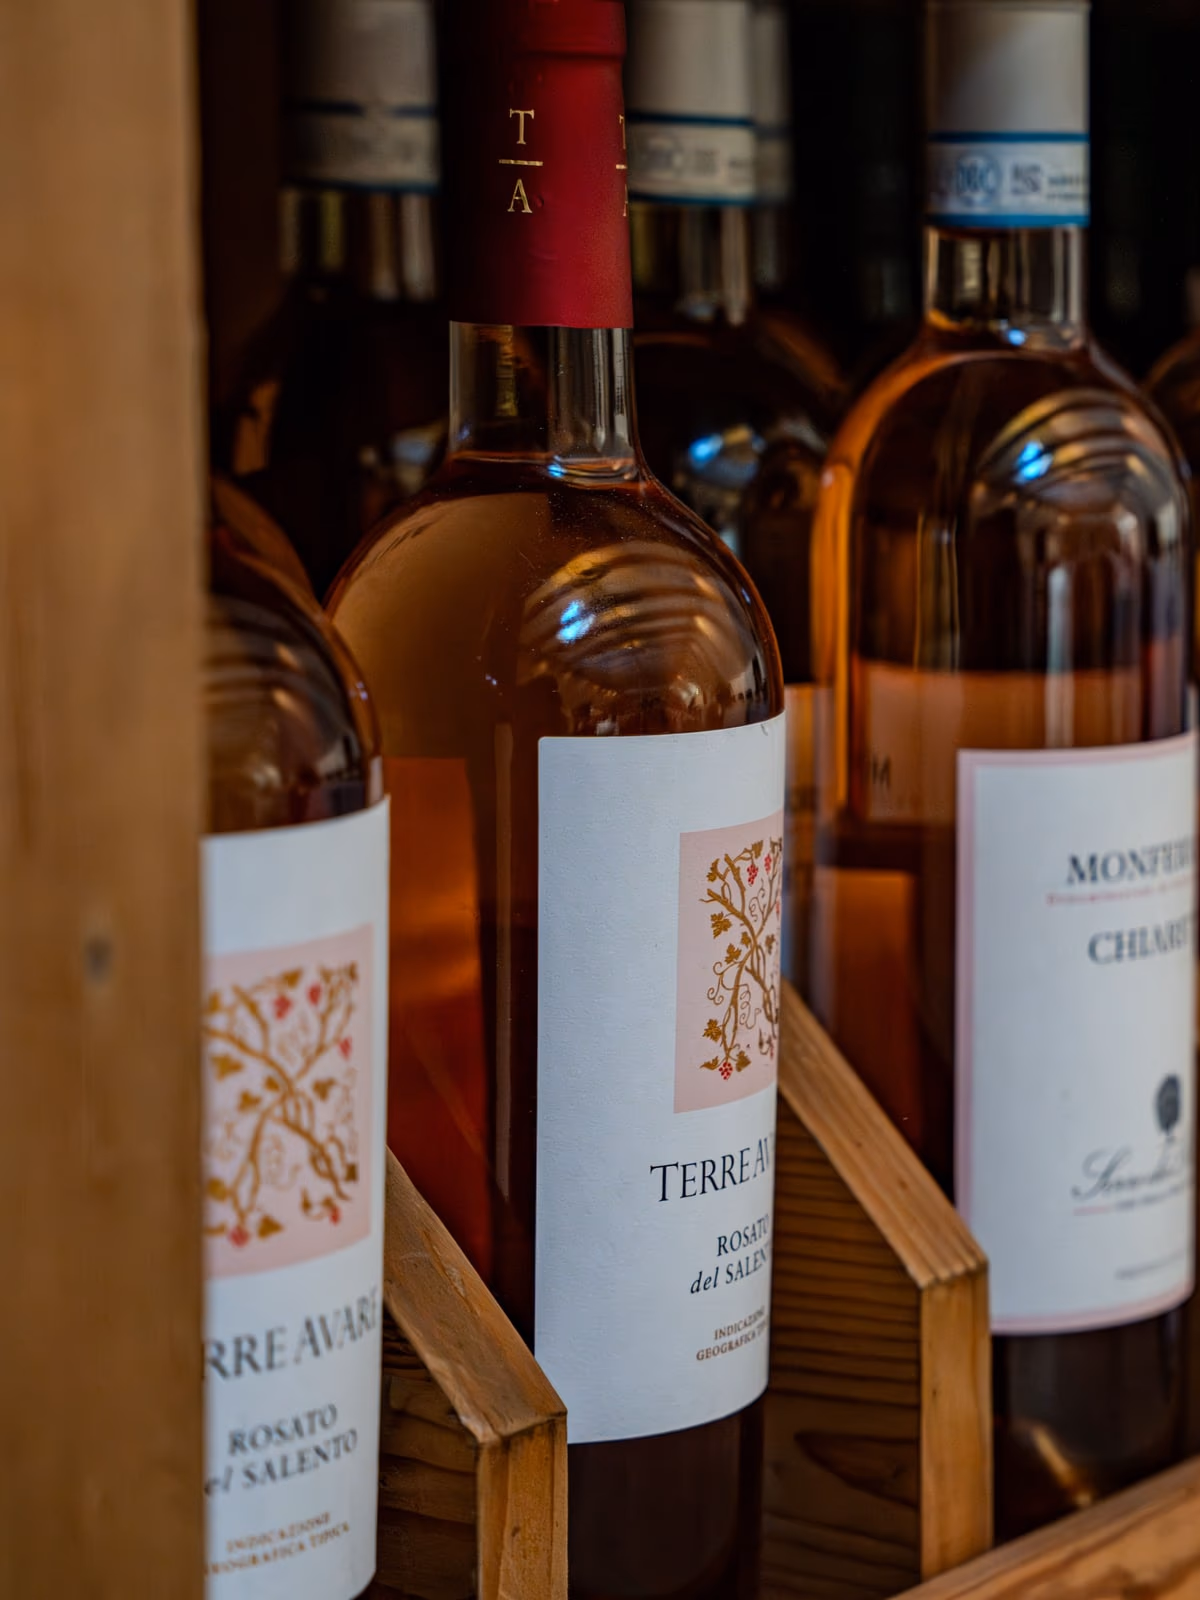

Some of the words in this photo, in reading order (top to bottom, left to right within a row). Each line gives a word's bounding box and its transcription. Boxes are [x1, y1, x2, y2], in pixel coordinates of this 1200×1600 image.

[509, 108, 535, 145] T
[507, 178, 533, 214] A
[649, 1146, 750, 1202] TERRE
[690, 1266, 719, 1294] del
[206, 1326, 288, 1380] RRE
[229, 1403, 337, 1456] ROSATO
[243, 1428, 358, 1489] SALENTO
